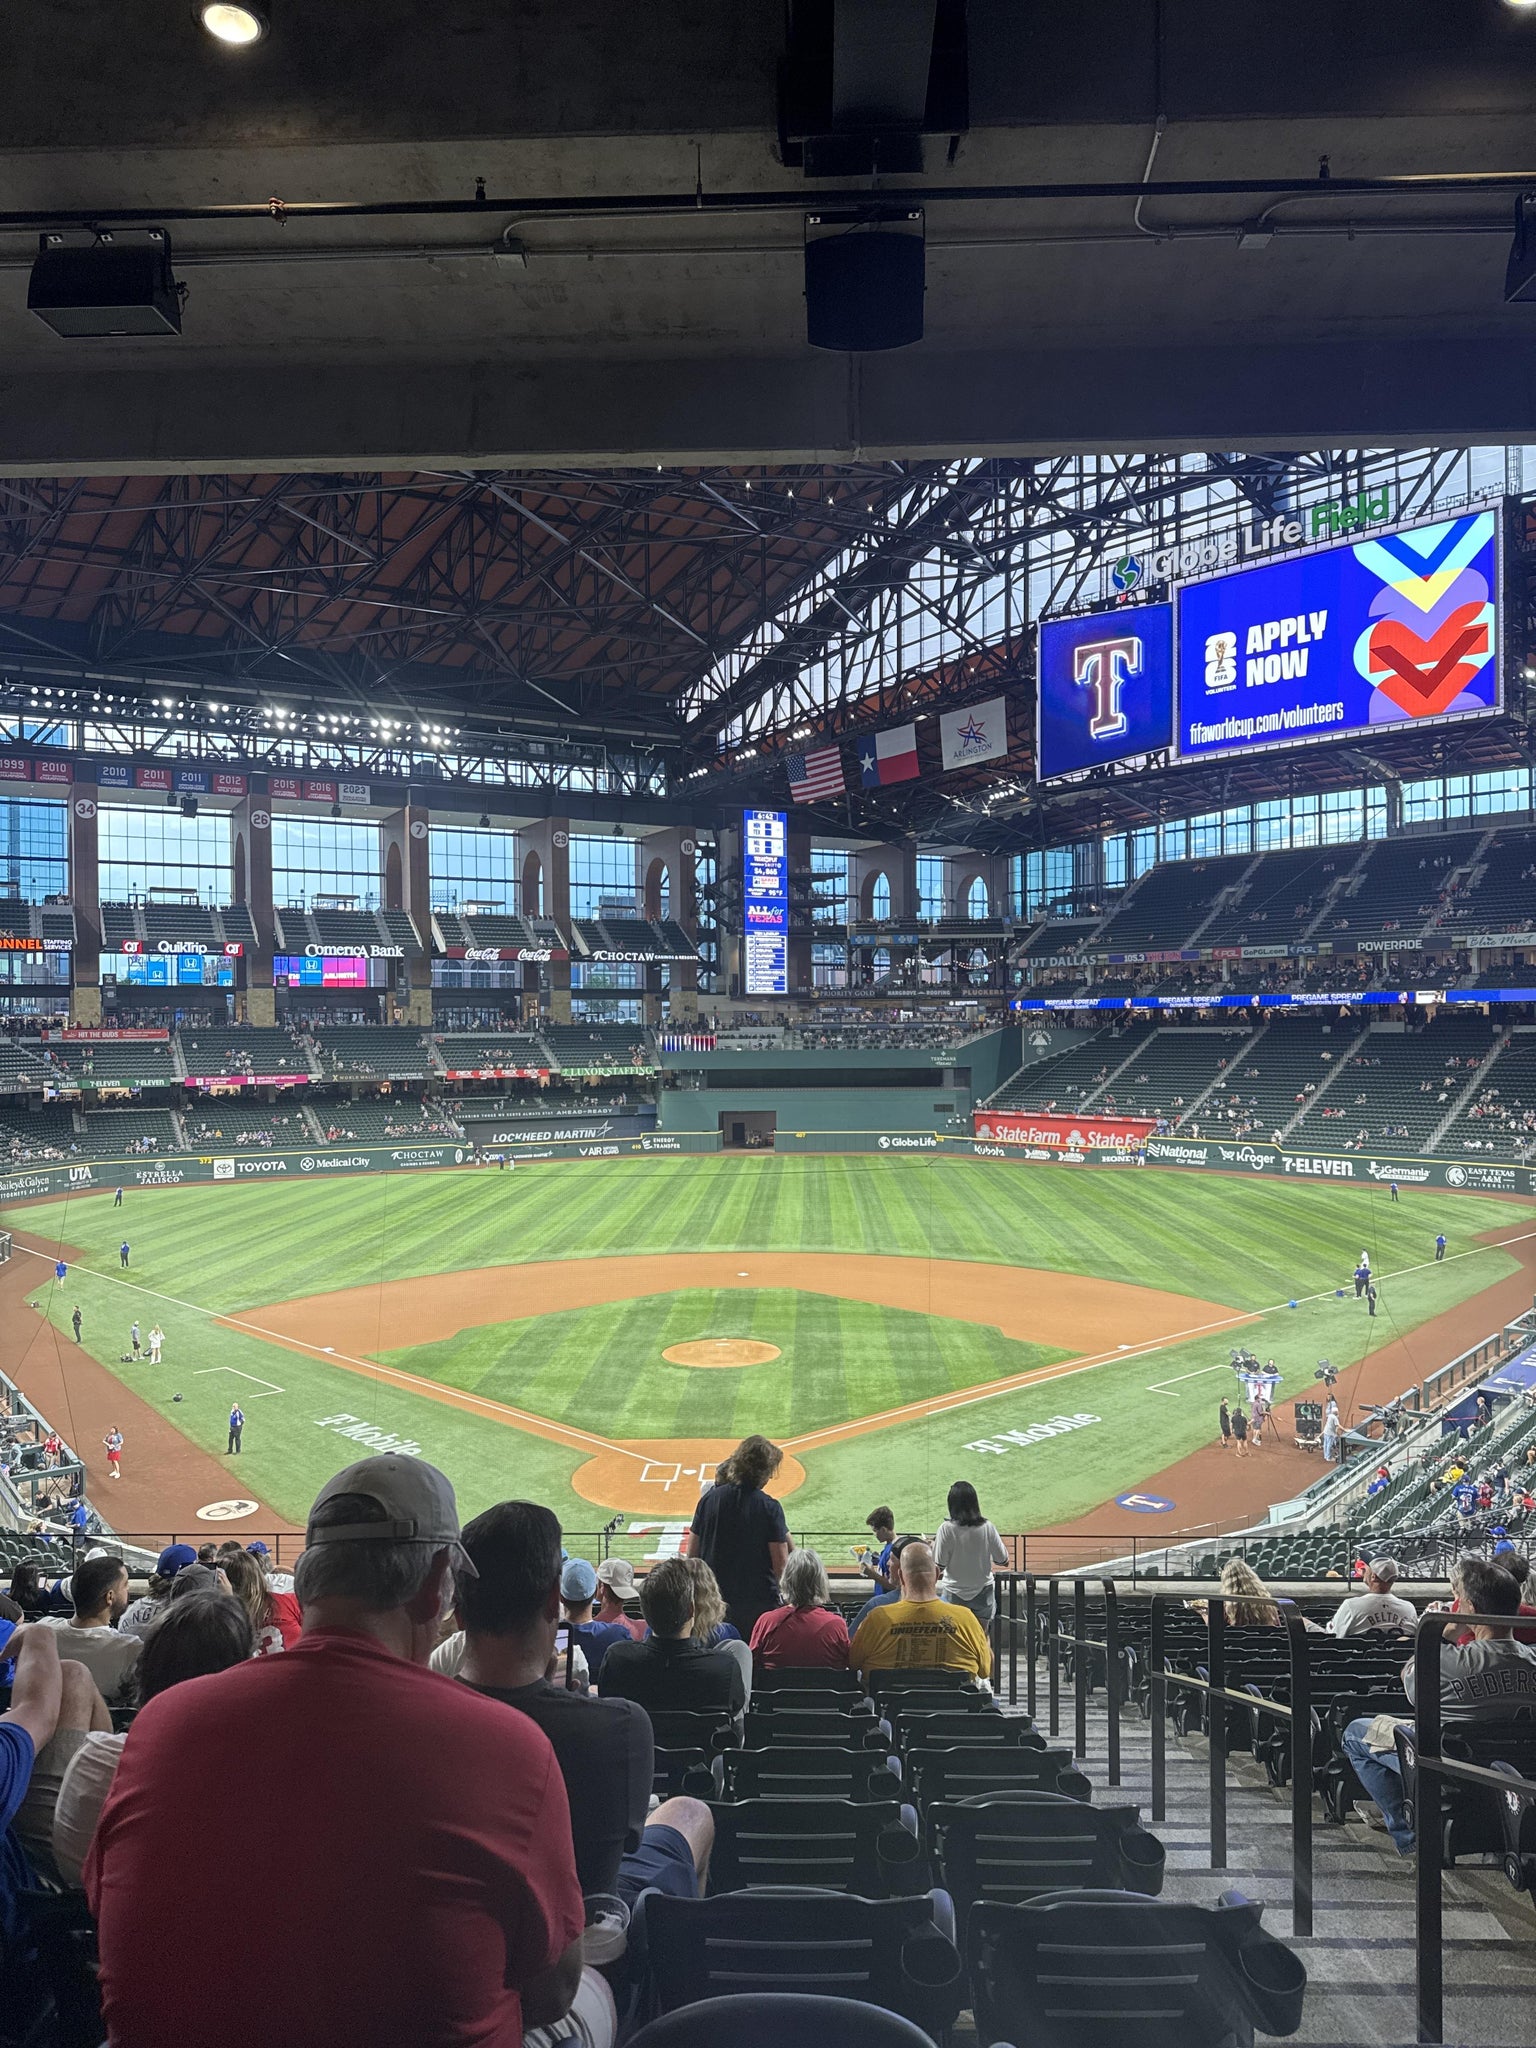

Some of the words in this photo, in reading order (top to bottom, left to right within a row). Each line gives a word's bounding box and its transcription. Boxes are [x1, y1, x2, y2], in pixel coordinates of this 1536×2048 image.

[1151, 538, 1238, 578] Globe
[1243, 514, 1303, 554] Life
[1311, 486, 1389, 537] Field
[1245, 609, 1328, 655] APPLY
[1246, 647, 1309, 688] NOW
[1214, 674, 1229, 682] FIFA
[1074, 636, 1142, 740] T
[1205, 684, 1237, 696] VOLUNTEER
[1190, 701, 1344, 745] fifaworldcup.com/volunteers
[953, 742, 993, 759] ARLINGTON
[0, 759, 25, 770] 1999
[42, 762, 67, 773] 2010
[102, 766, 127, 777] 2010
[143, 769, 165, 780] 2011
[181, 772, 202, 783] 2011
[219, 775, 242, 785] 2012
[273, 779, 296, 790] 2015
[310, 782, 331, 792] 2016
[343, 784, 366, 795] 2023
[77, 803, 96, 815] 34
[253, 814, 269, 826] 26
[415, 823, 423, 836] 7
[554, 833, 567, 846] 29
[682, 842, 693, 853] 10
[748, 905, 769, 915] ALL
[769, 906, 784, 918] for
[748, 914, 783, 923] TEXAS
[1357, 939, 1423, 951] POWERADE
[1469, 934, 1494, 946] Blue
[1500, 934, 1532, 945] Mint
[124, 941, 139, 952] QT
[157, 940, 207, 954] QuikTrip
[225, 944, 240, 954] QT
[370, 945, 404, 957] Bank
[1243, 947, 1285, 956] GoPGL.com
[1296, 945, 1316, 953] PGL
[600, 950, 654, 961] CHOCTAW
[1030, 957, 1048, 967] UT
[1051, 954, 1096, 967] DALLAS
[1124, 953, 1144, 962] 105.3
[854, 989, 875, 997] GOLD
[1291, 993, 1328, 1001] PREGAME
[1330, 992, 1362, 1001] SPREAD
[1193, 996, 1219, 1004] SPREAD
[606, 1066, 652, 1075] STAFFING
[492, 1131, 552, 1143] LOCKHEED
[553, 1127, 596, 1139] MARTIN
[892, 1137, 919, 1147] Globe
[920, 1136, 937, 1146] Life
[399, 1151, 443, 1159] CHOCTAW
[588, 1148, 602, 1156] AIR
[974, 1145, 1005, 1157] Kubota
[1160, 1146, 1208, 1160] National
[316, 1159, 352, 1168] Medical
[352, 1157, 370, 1167] City
[1236, 1146, 1275, 1170] Kroger
[237, 1161, 286, 1173] TOYOTA
[1385, 1166, 1429, 1177] Germania
[69, 1166, 92, 1181] UTA
[136, 1170, 184, 1178] ESTRELLA
[141, 1176, 180, 1184] JALISCO
[0, 1190, 27, 1199] TTORNEYS
[890, 1627, 957, 1635] UNDEFEATED
